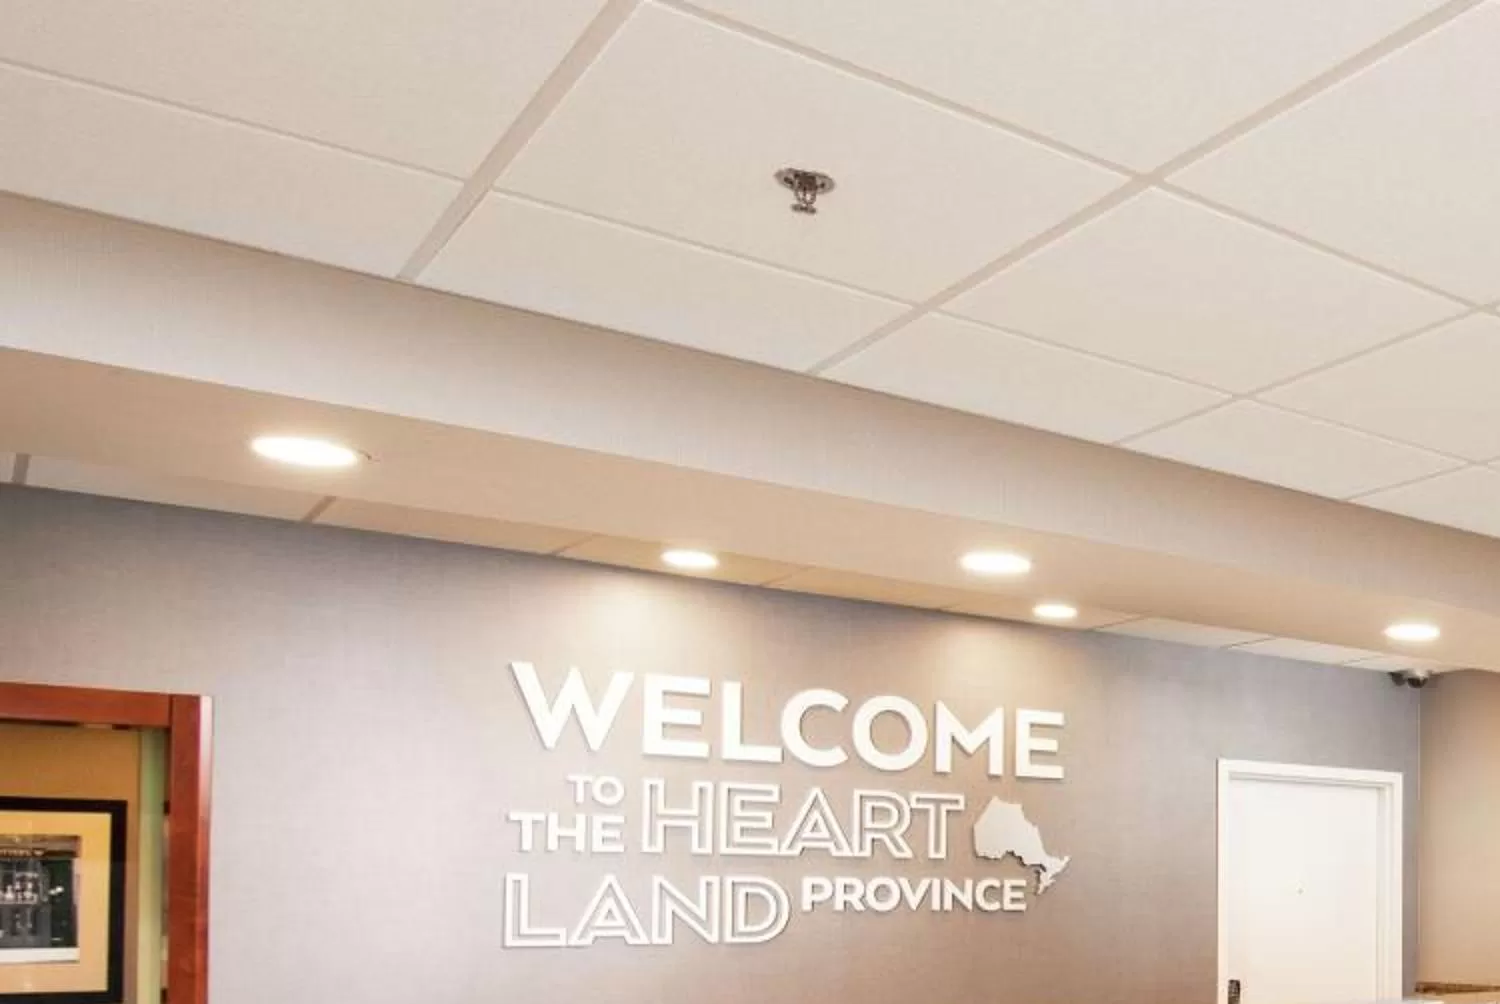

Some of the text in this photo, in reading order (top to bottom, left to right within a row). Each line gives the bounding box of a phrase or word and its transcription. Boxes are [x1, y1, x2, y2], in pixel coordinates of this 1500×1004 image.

[509, 661, 1064, 780] WELCOME
[507, 777, 965, 861] THE HEART
[567, 773, 625, 806] TO
[502, 872, 1027, 948] LAND PROVINCE
